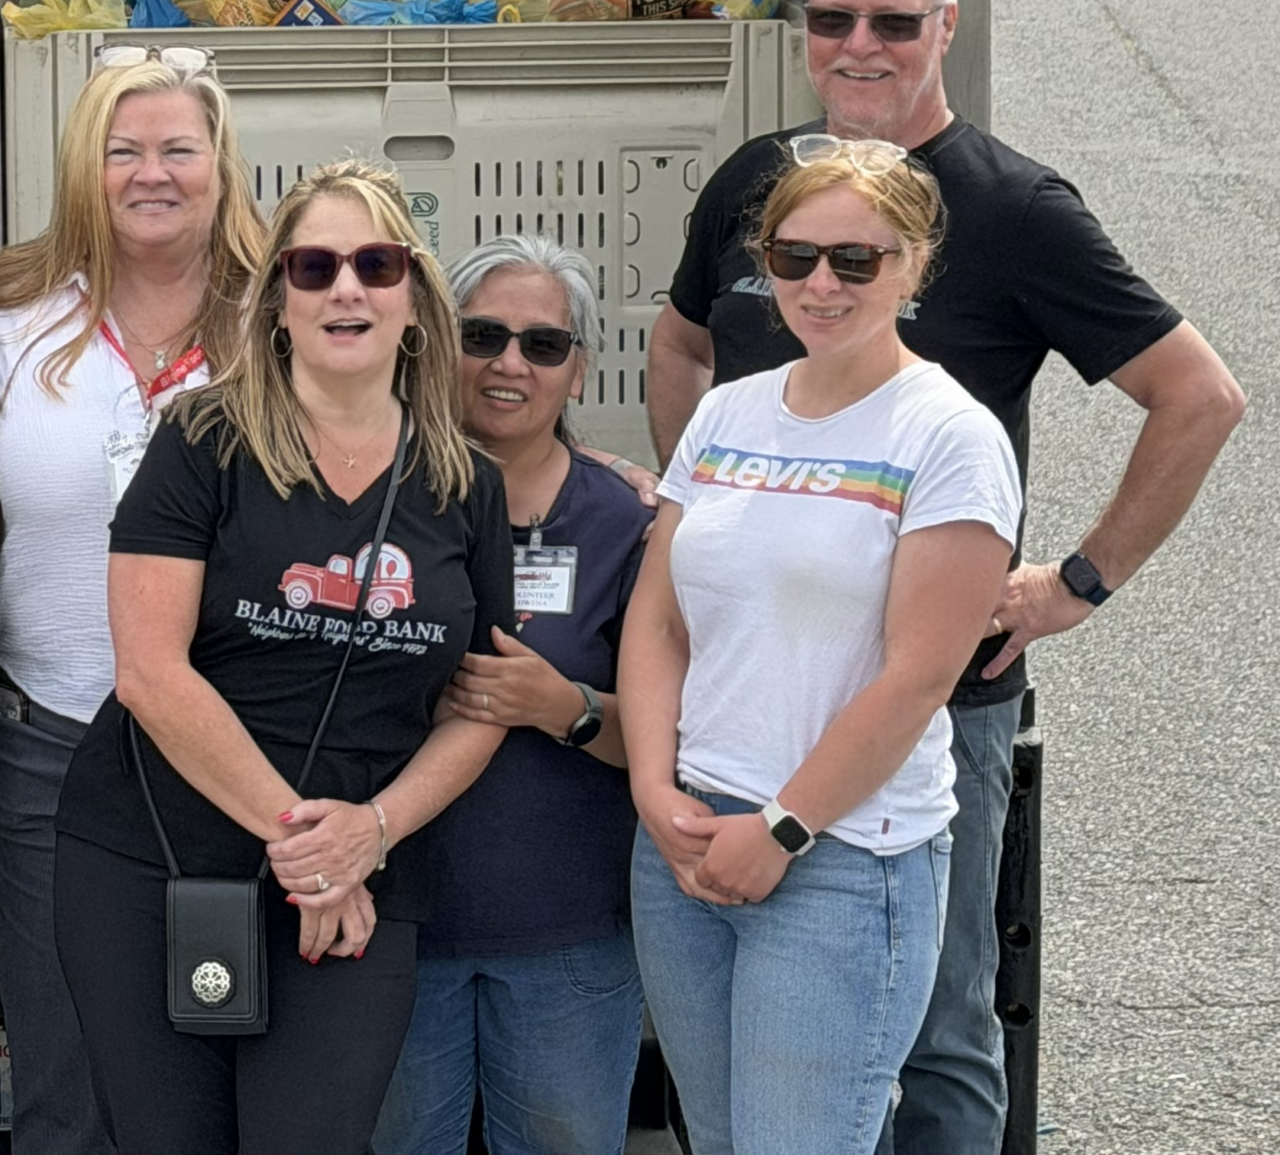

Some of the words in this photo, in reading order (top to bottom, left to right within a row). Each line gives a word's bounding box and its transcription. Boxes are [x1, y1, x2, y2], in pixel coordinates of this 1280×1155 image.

[643, 0, 667, 16] THIS
[234, 599, 322, 632] BLAINE
[383, 620, 447, 643] BANK
